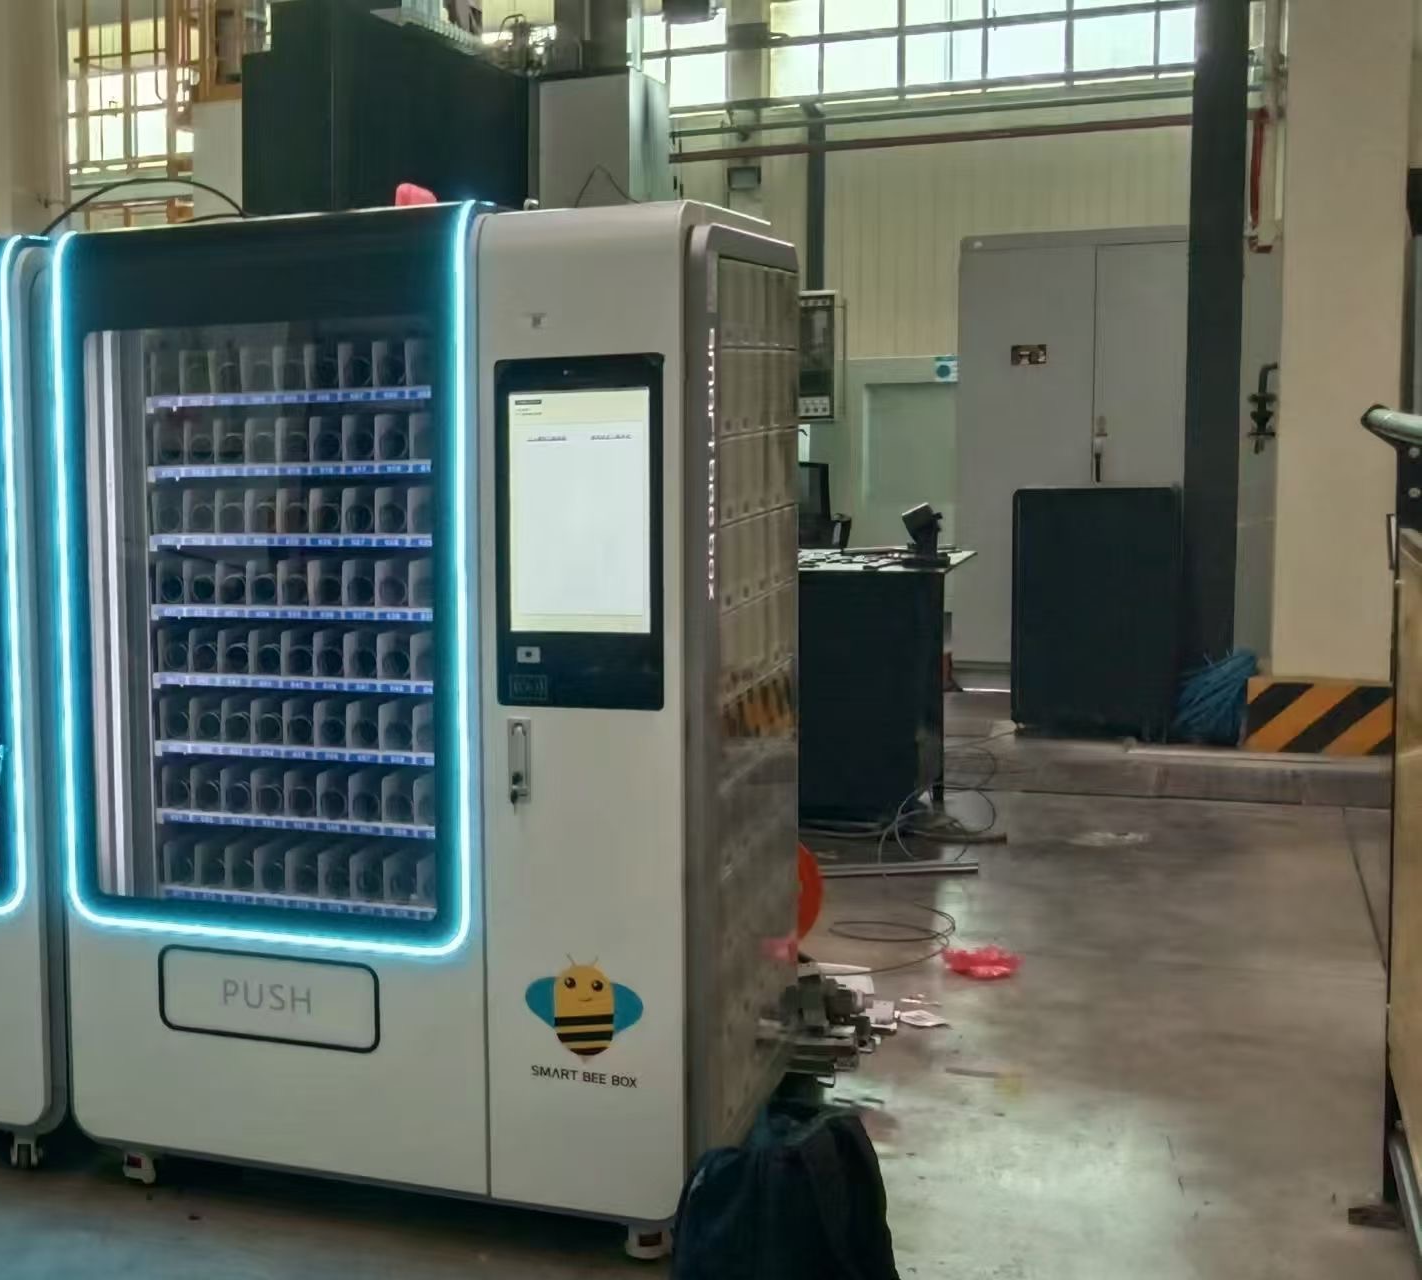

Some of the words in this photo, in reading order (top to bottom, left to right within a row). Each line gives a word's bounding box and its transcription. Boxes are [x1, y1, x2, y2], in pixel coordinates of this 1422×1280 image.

[223, 979, 311, 1015] PUSH
[531, 1065, 578, 1081] SMART
[582, 1071, 607, 1085] BEE
[611, 1074, 638, 1088] BOX
